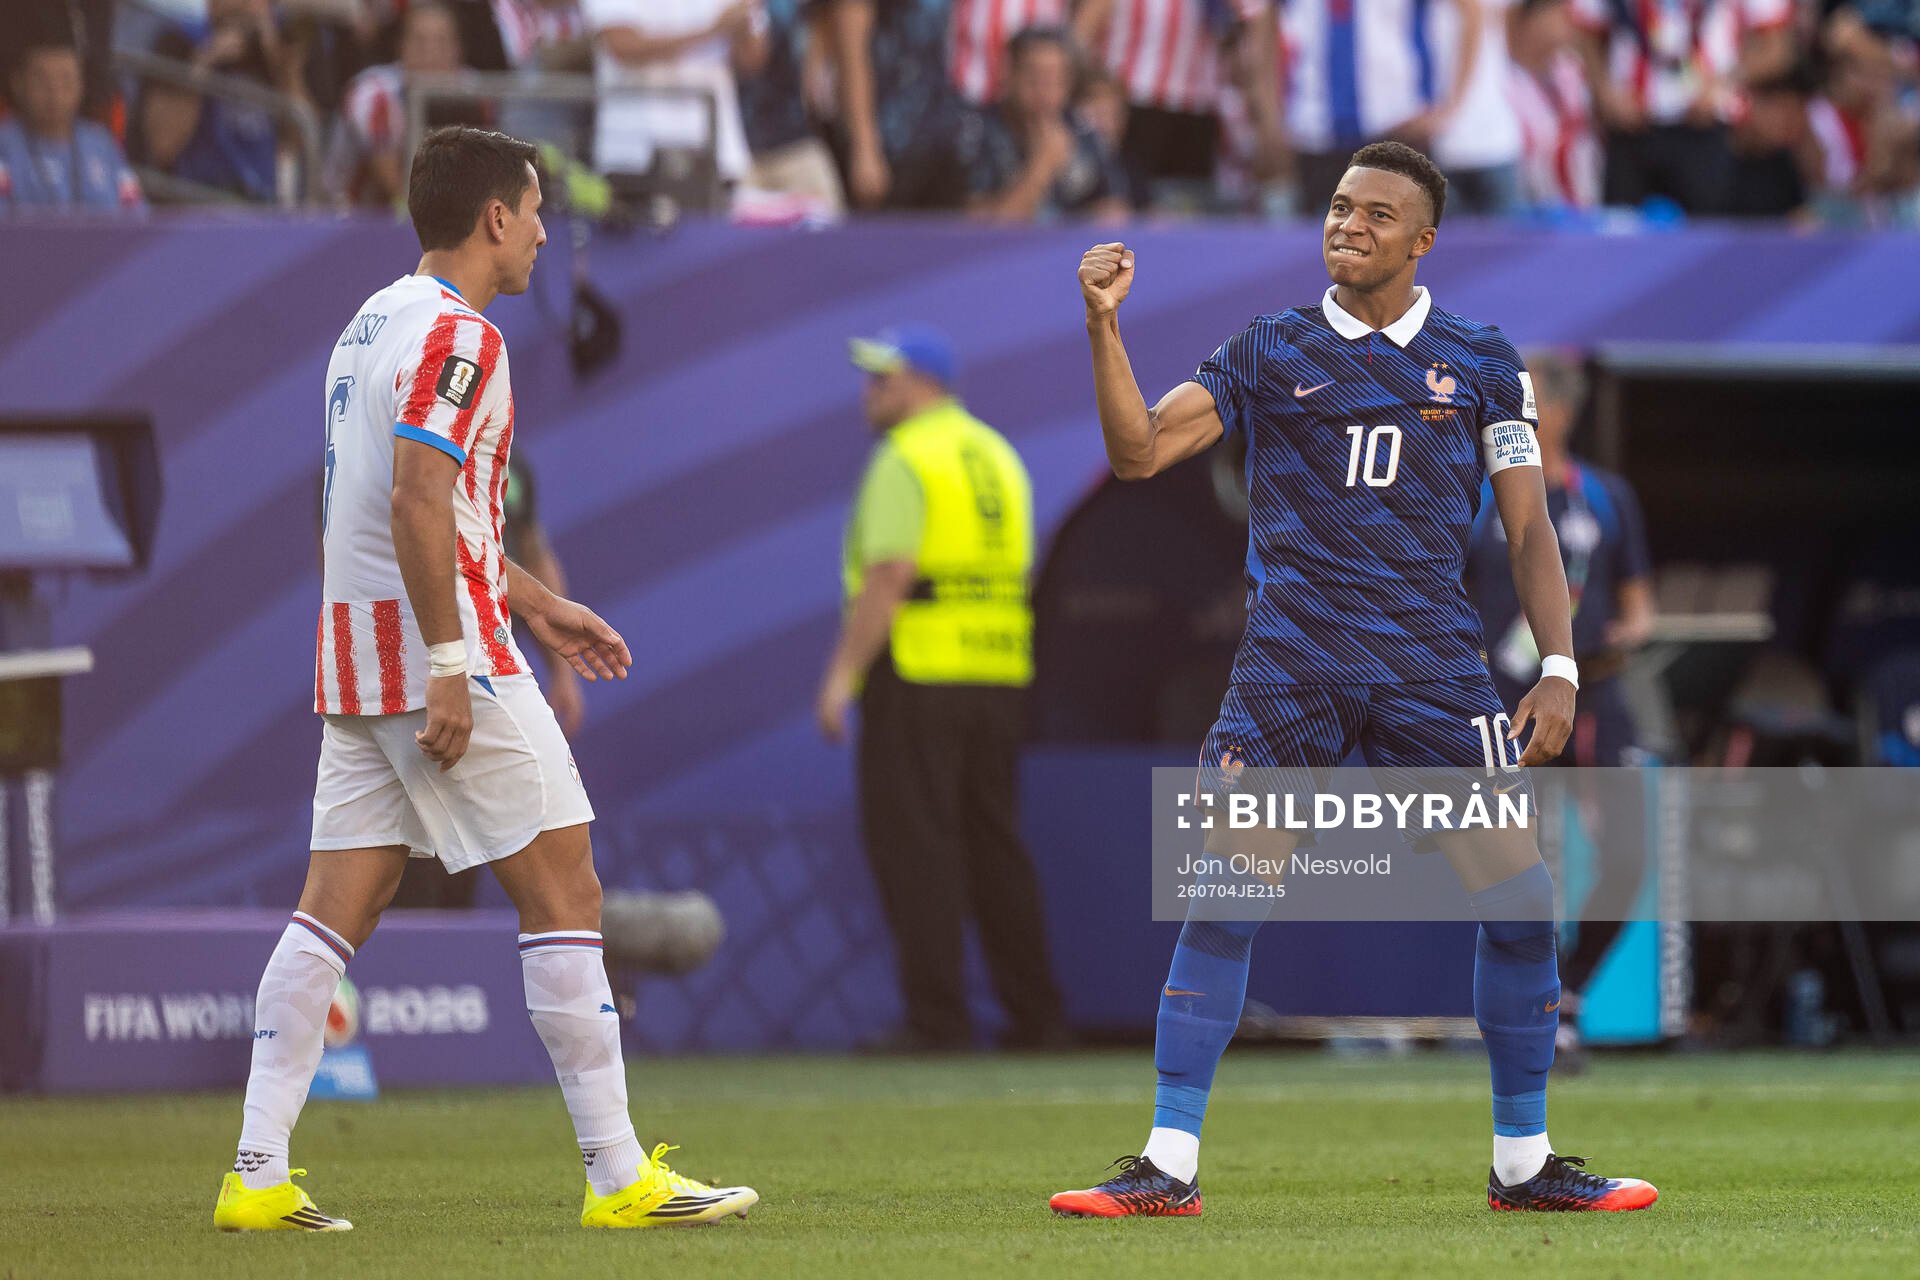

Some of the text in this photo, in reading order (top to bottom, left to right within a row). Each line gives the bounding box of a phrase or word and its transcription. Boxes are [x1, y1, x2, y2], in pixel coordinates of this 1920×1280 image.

[1493, 424, 1527, 437] FOOTBALL
[1494, 433, 1530, 448] UNITES
[1345, 425, 1402, 487] 10
[1495, 444, 1535, 459] the World
[1470, 712, 1521, 778] 10
[84, 993, 160, 1041] FIFA
[365, 985, 488, 1034] 2026
